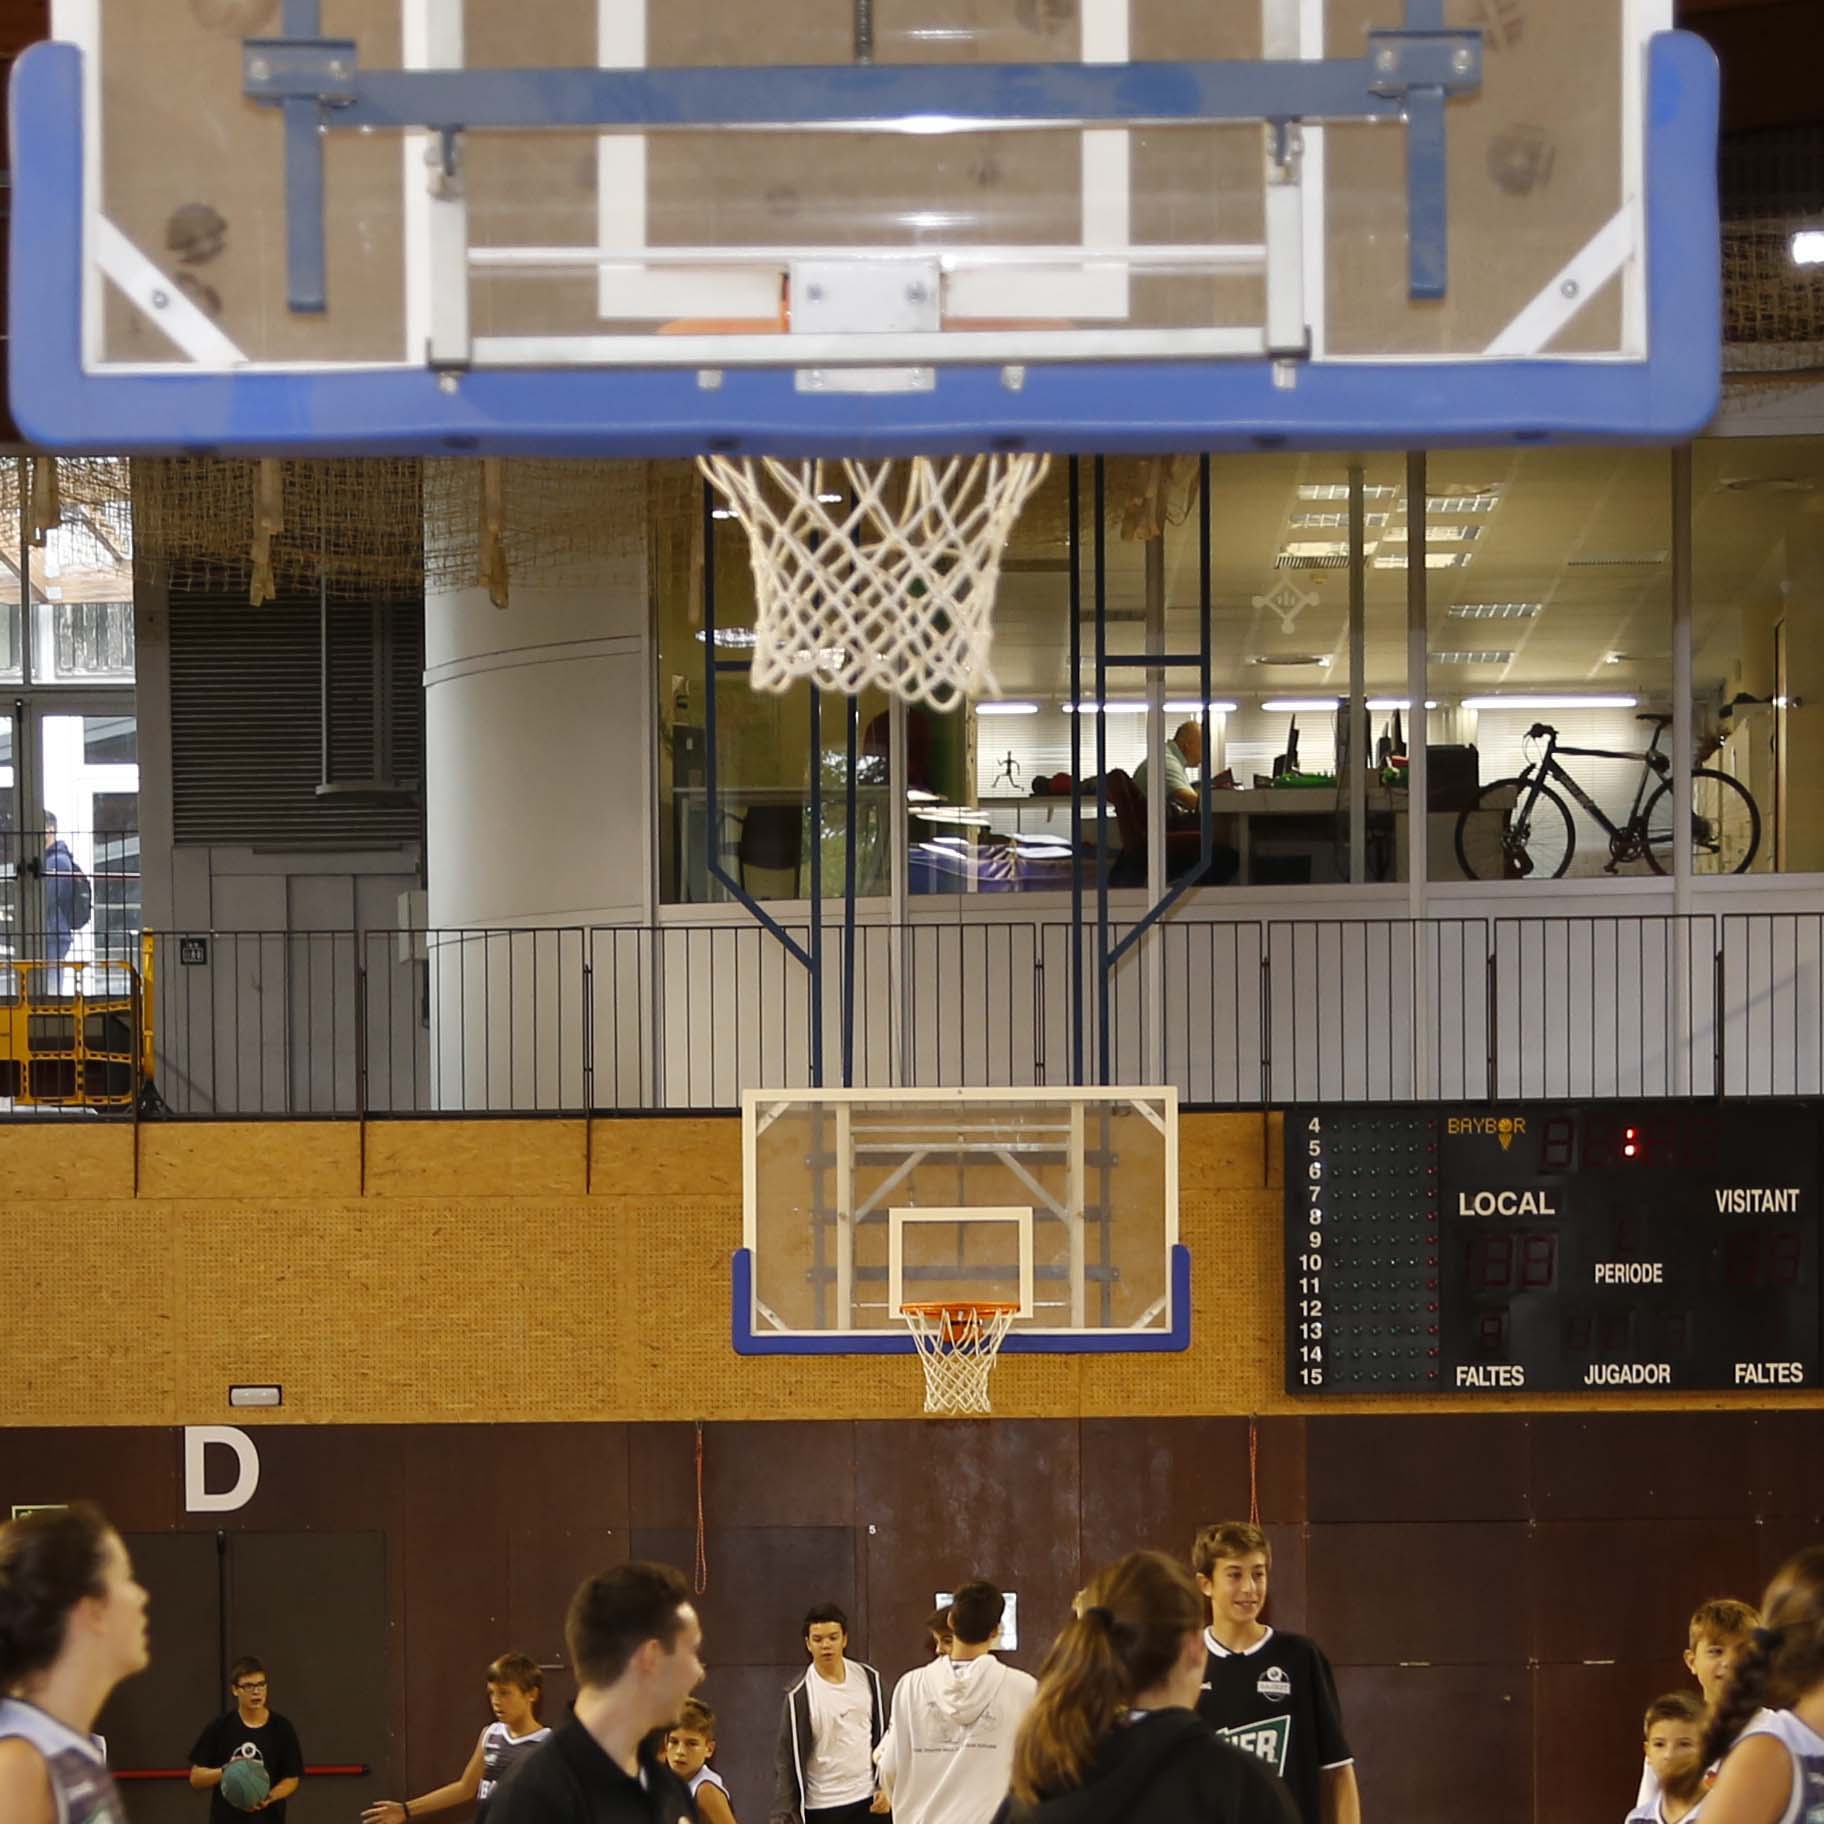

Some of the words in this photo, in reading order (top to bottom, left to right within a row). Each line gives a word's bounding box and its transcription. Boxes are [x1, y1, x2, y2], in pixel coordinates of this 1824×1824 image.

[1308, 1117, 1321, 1133] 4
[1308, 1139, 1321, 1157] 5
[1308, 1161, 1322, 1180] 6
[1308, 1185, 1321, 1203] 7
[1715, 1188, 1800, 1213] VISITANT
[1459, 1191, 1556, 1216] LOCAL
[1309, 1208, 1322, 1225] 8
[1309, 1231, 1322, 1249] 9
[1299, 1254, 1322, 1271] 10
[1594, 1262, 1663, 1284] PERIODE
[1299, 1277, 1320, 1294] 11
[1299, 1300, 1322, 1317] 12
[1299, 1321, 1322, 1340] 13
[1299, 1345, 1323, 1363] 14
[1300, 1368, 1323, 1385] 15
[1456, 1365, 1525, 1387] FALTES
[1583, 1363, 1671, 1385] JUGADOR
[1735, 1362, 1804, 1384] FALTES
[184, 1425, 260, 1512] D
